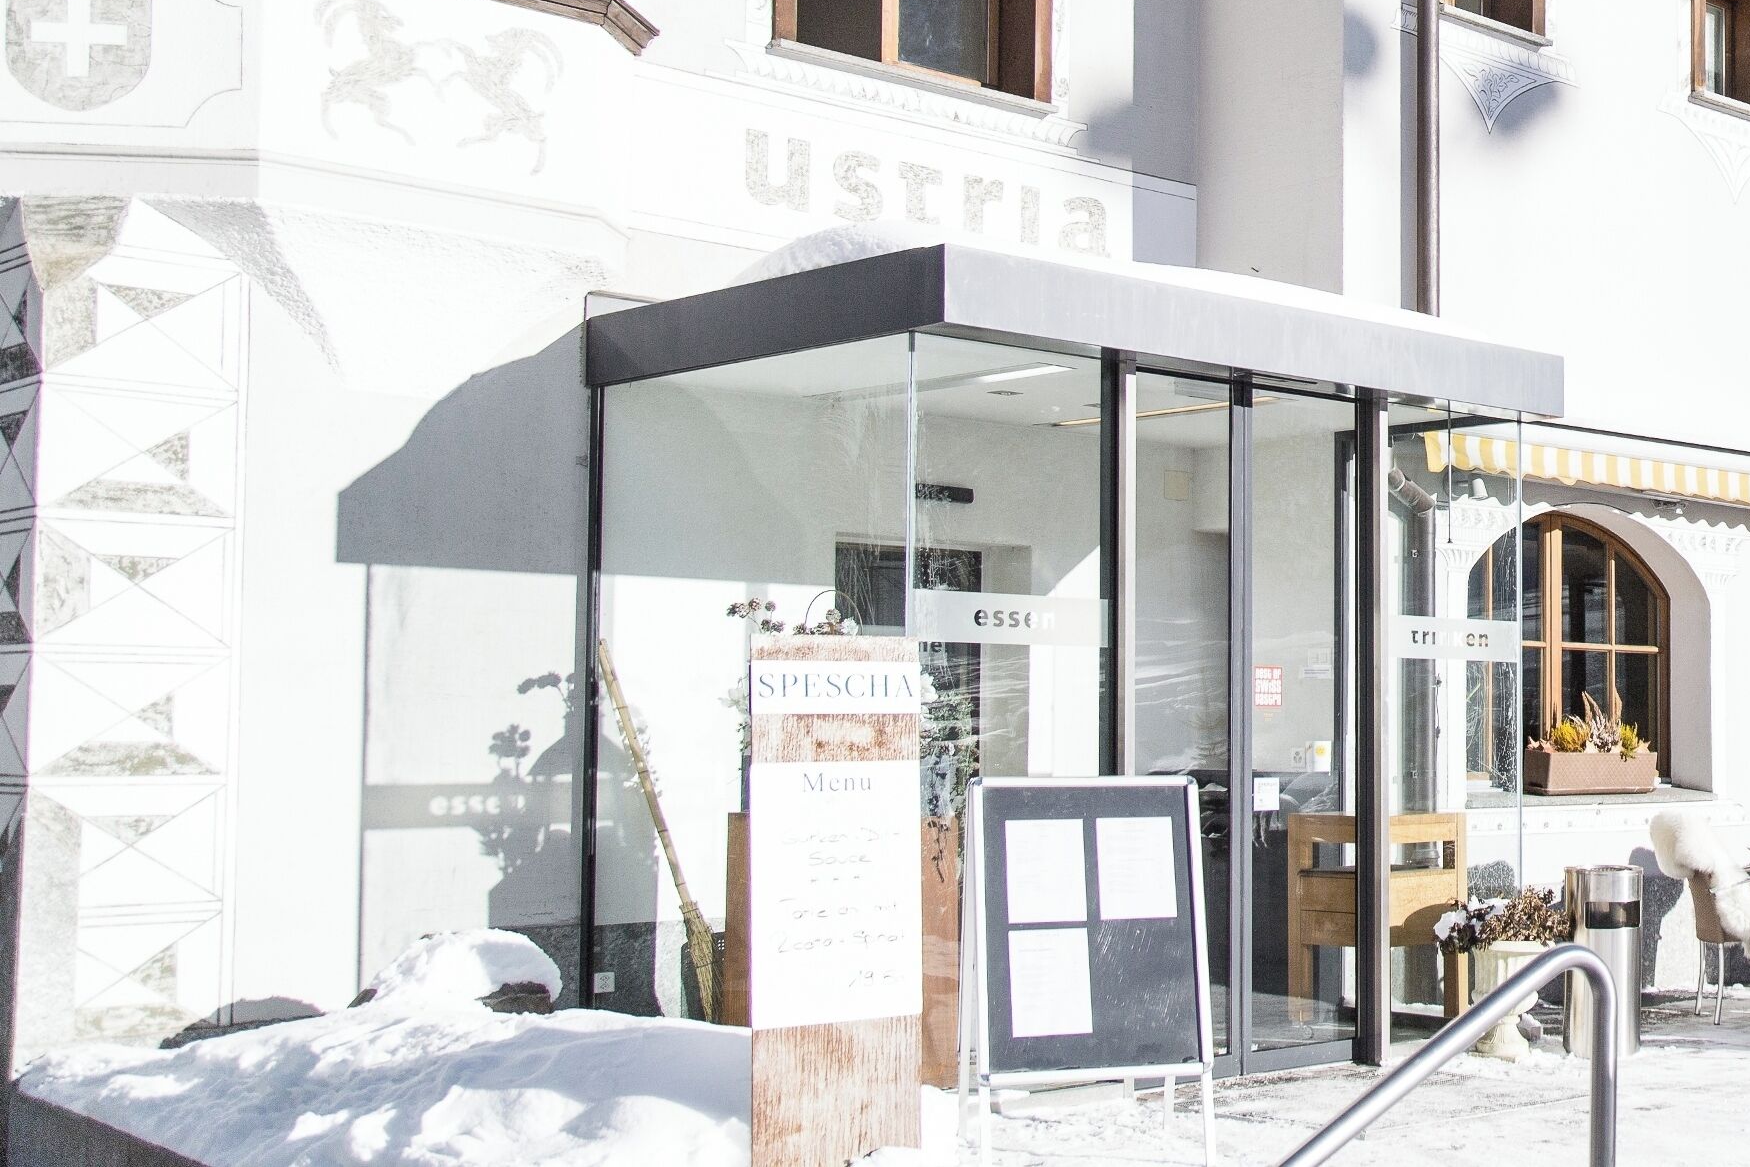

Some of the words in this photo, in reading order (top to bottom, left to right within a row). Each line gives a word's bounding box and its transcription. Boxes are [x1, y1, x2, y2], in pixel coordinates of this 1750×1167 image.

[744, 127, 1113, 259] ustria
[973, 608, 1055, 630] essen
[1410, 629, 1489, 648] trinken
[758, 672, 914, 699] SPESCHA
[802, 771, 872, 793] Menu
